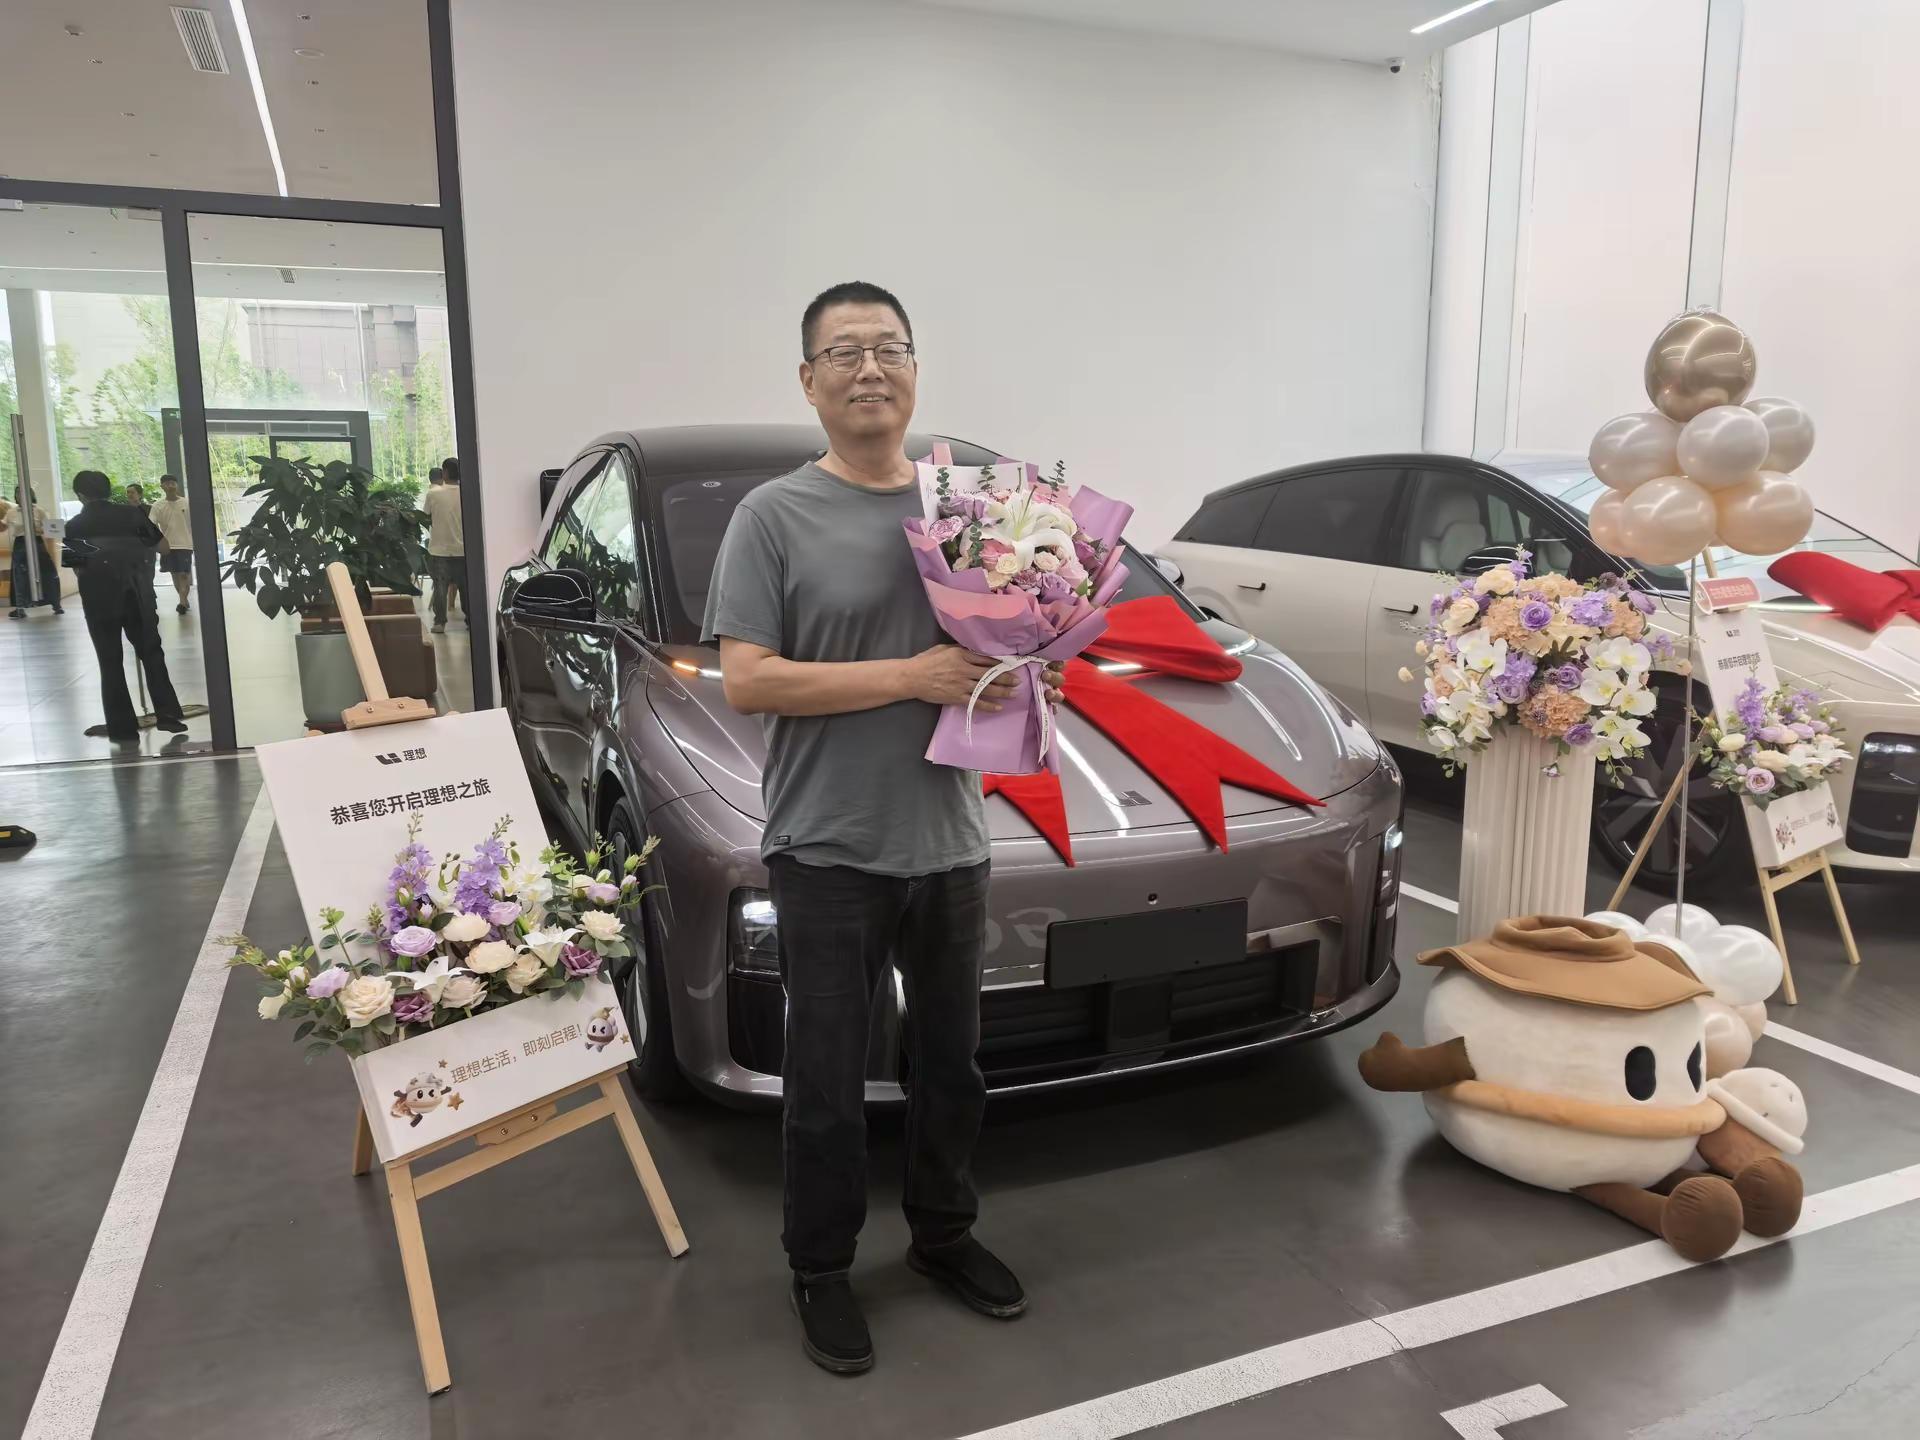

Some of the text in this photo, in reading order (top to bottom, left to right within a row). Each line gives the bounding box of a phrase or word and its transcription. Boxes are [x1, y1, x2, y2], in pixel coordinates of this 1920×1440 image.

[402, 747, 428, 762] 理想
[330, 777, 492, 826] 恭喜您开启理想之旅
